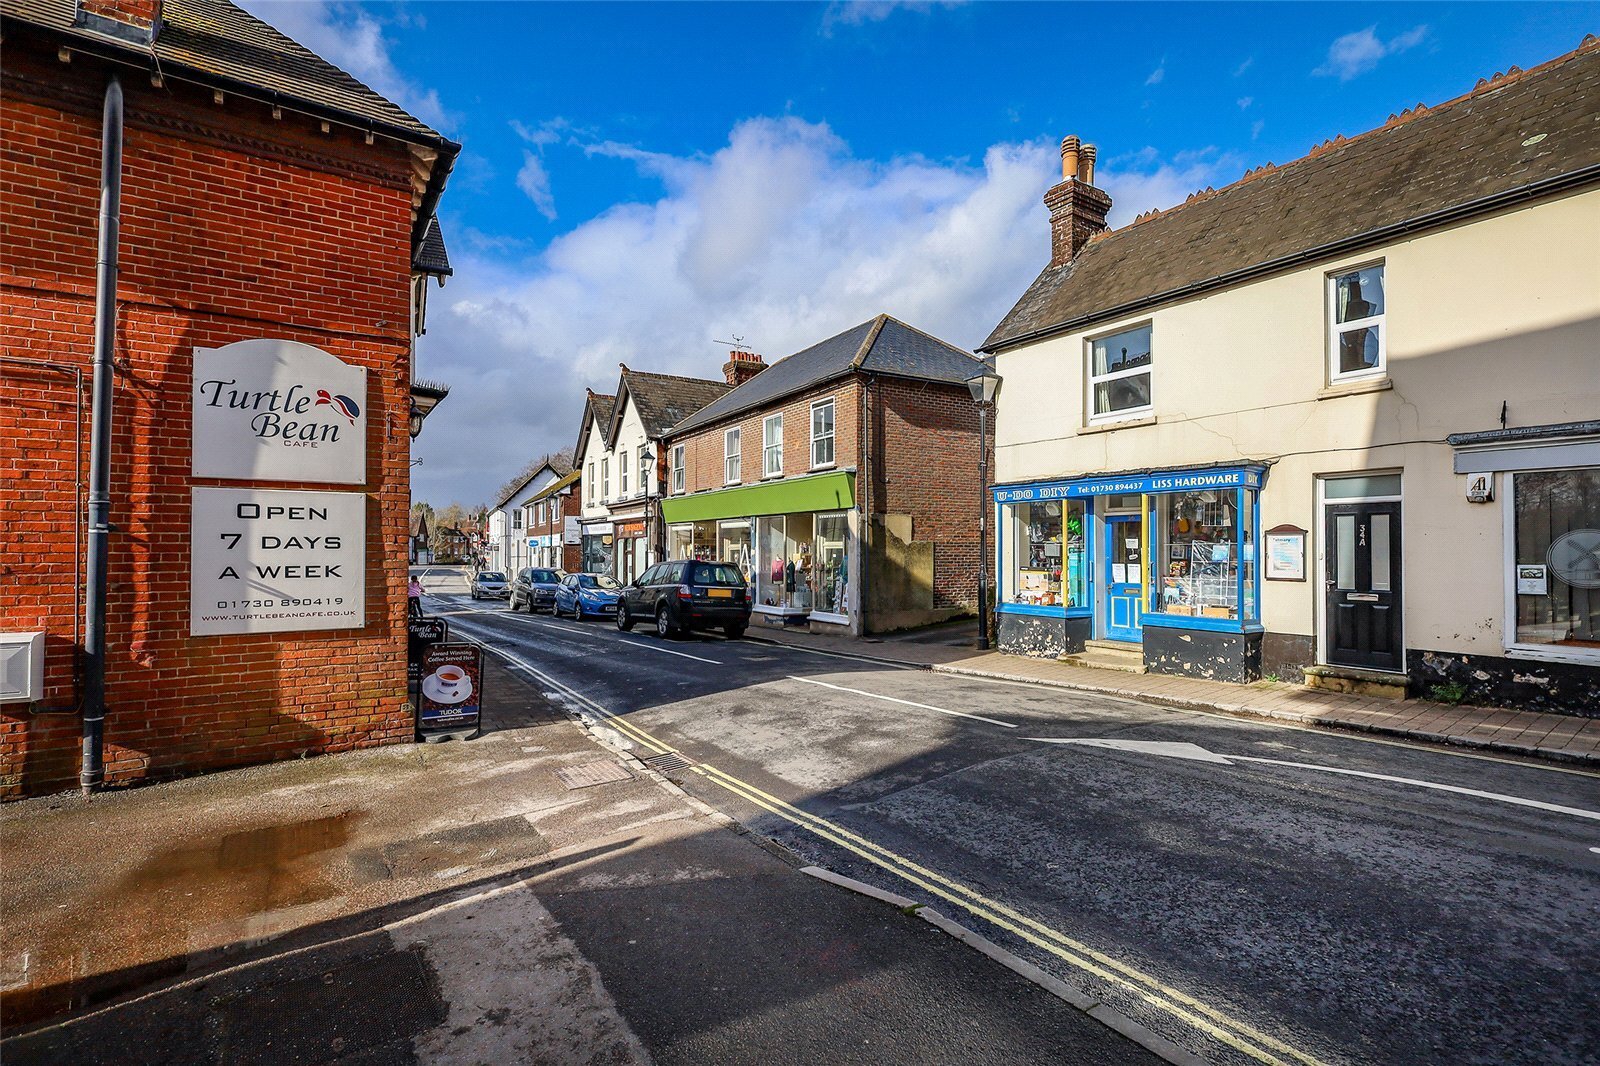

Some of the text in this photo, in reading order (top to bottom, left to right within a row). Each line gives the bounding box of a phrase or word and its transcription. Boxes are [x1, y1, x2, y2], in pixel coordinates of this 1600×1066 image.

[200, 379, 311, 414] Turtle
[251, 412, 340, 443] Bean
[283, 440, 318, 448] CAFE
[1152, 473, 1239, 488] LISS HARDWARE
[1247, 474, 1258, 484] DIY
[996, 486, 1070, 501] U-DO DIY
[1090, 485, 1113, 493] 01730
[1114, 482, 1143, 491] 894437
[237, 503, 328, 520] OPEN
[220, 533, 341, 550] 7 DAYS
[218, 565, 342, 579] A WEEK
[217, 597, 343, 609] 01730 890419
[409, 625, 431, 633] Turtle
